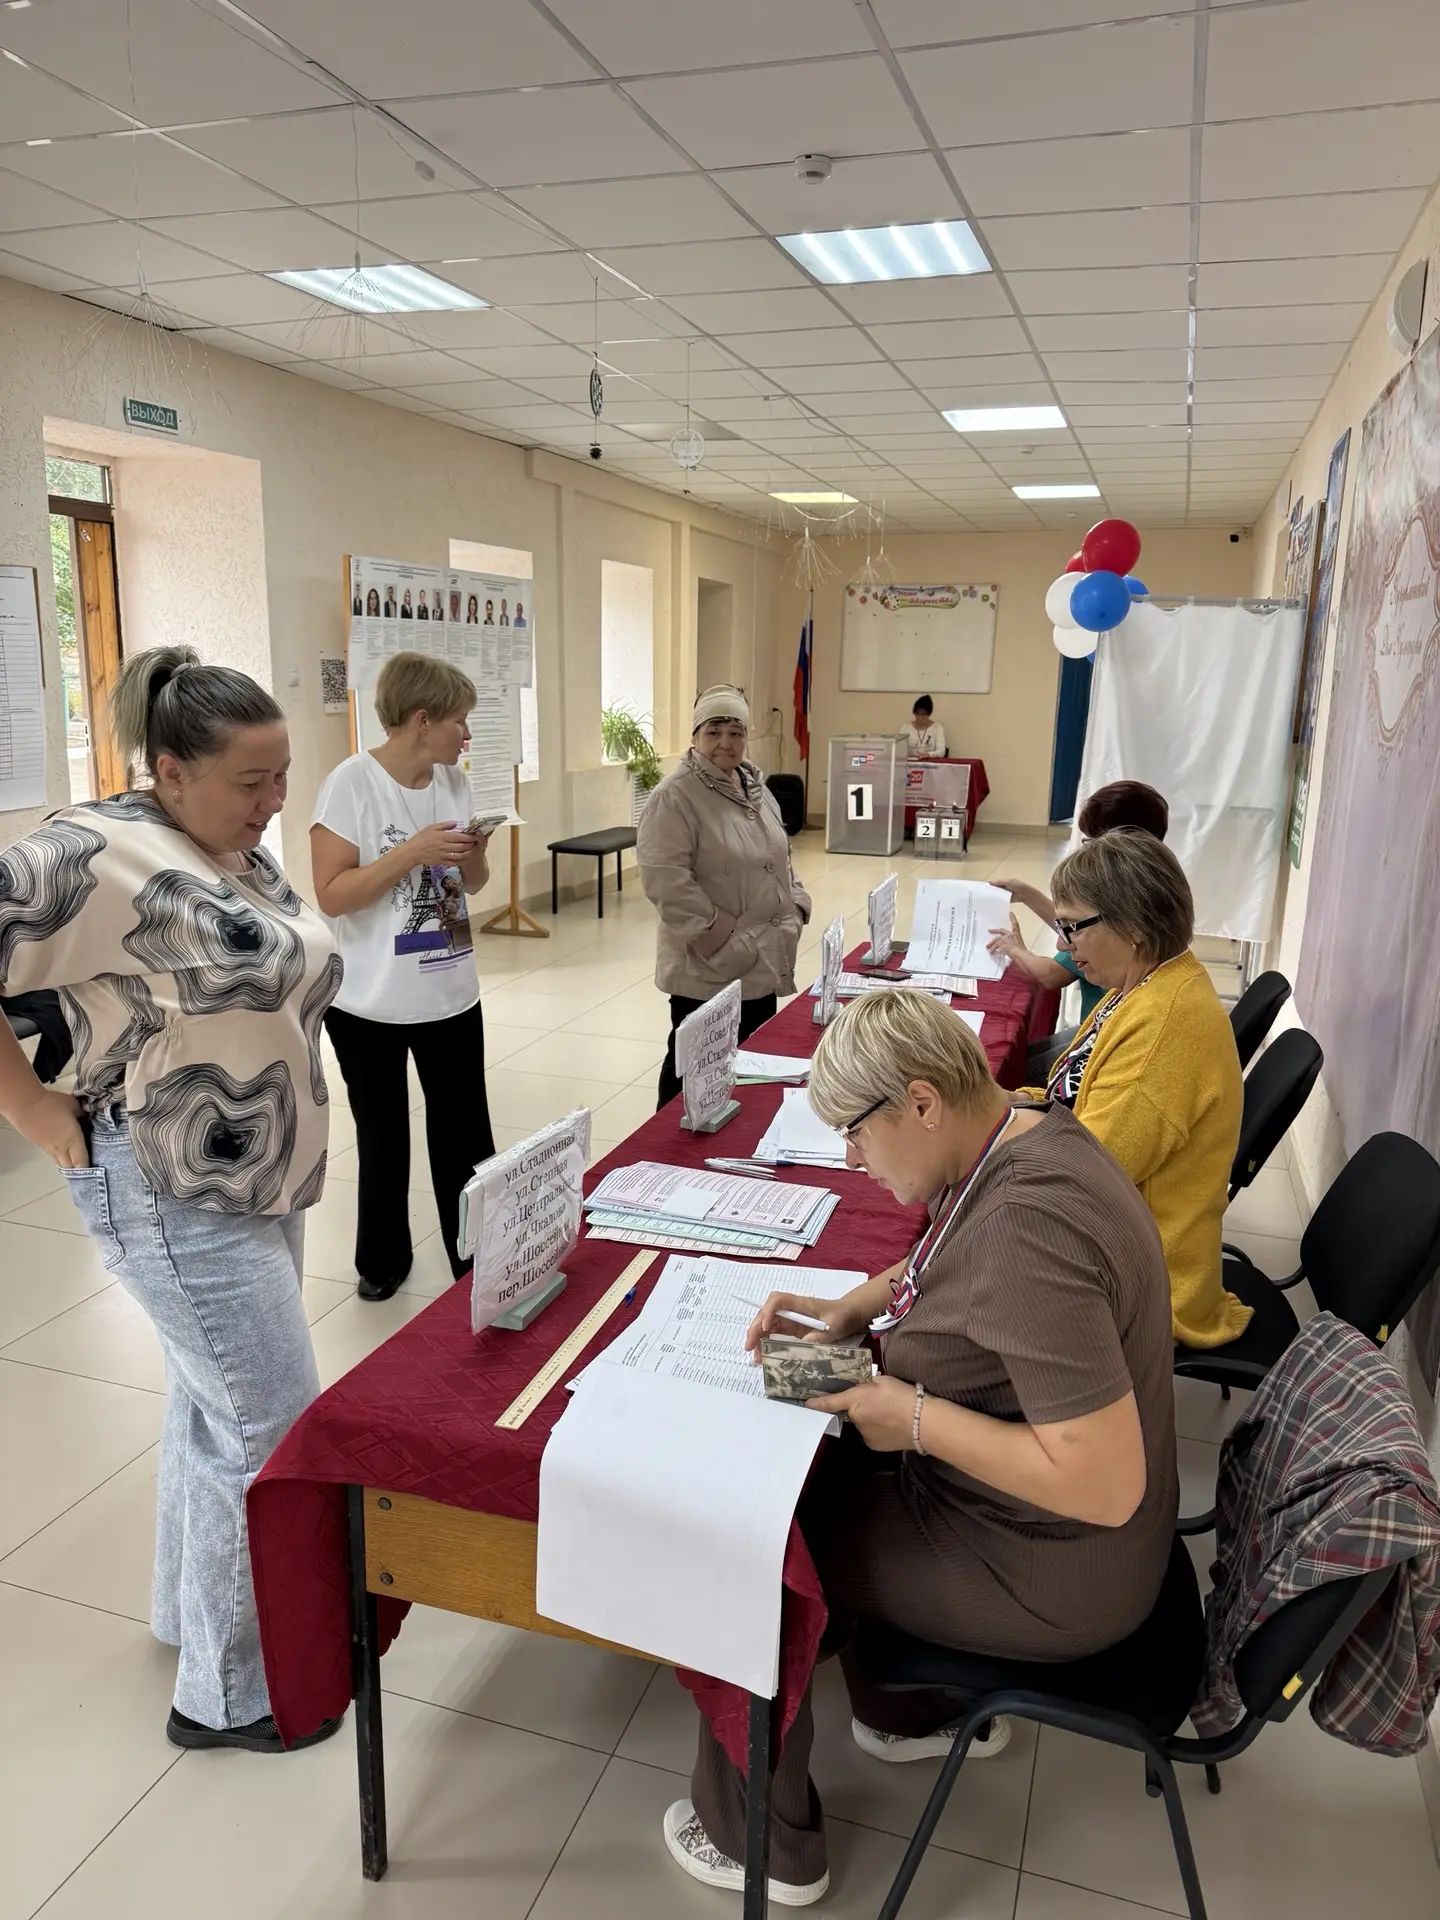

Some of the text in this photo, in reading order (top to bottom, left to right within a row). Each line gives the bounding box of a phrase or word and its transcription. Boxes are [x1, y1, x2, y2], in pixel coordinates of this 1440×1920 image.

[131, 403, 175, 427] ВЫХОД
[850, 787, 864, 817] 1
[921, 825, 931, 836] 2
[946, 826, 954, 837] 1
[504, 1133, 576, 1189] ул.Стадионная
[515, 1158, 568, 1206] ул.Степная
